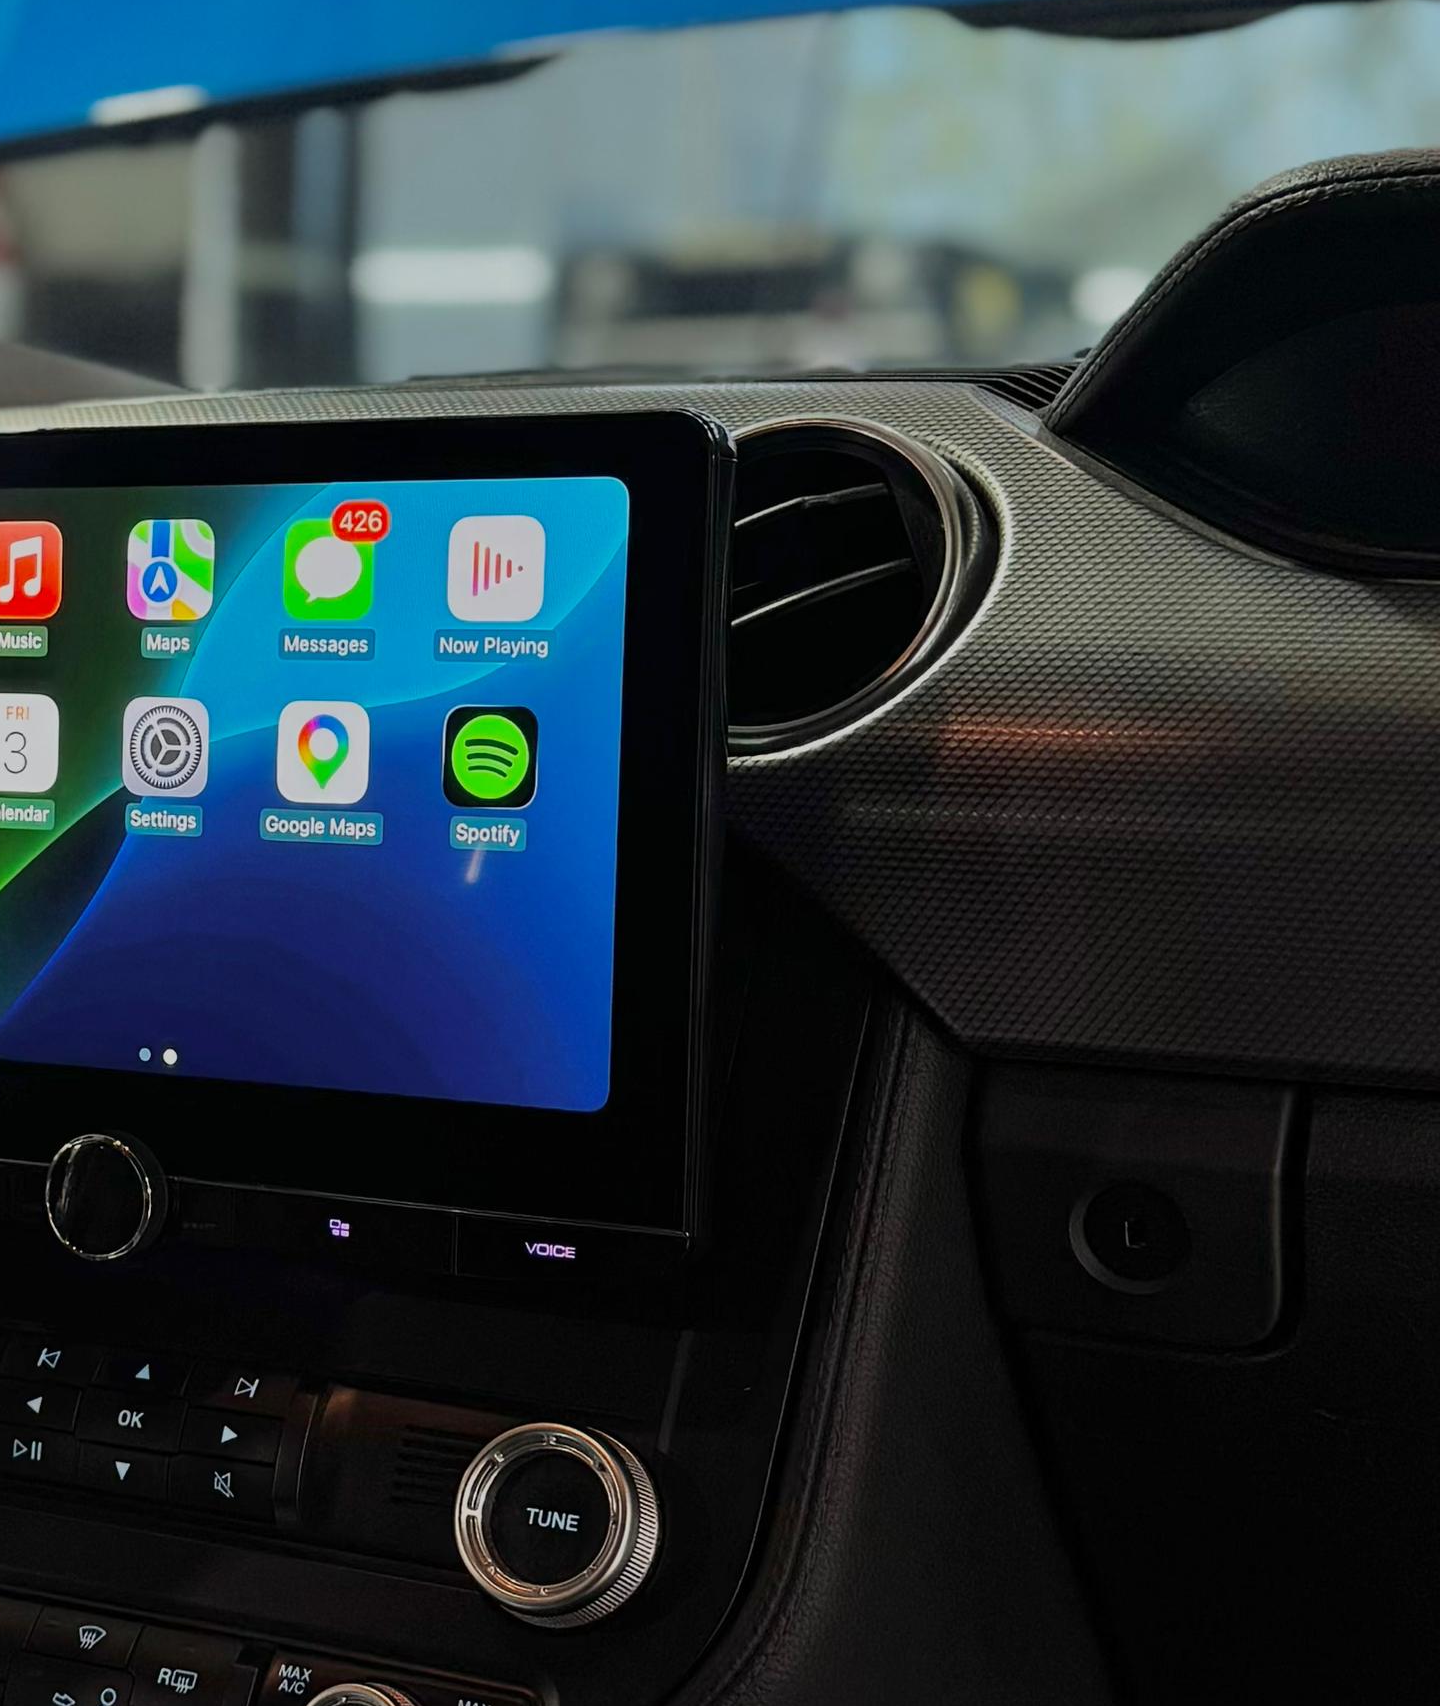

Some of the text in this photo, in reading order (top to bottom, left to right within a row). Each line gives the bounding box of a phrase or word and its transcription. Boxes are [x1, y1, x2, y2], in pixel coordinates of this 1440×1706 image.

[339, 509, 383, 533] 426
[146, 633, 191, 653] Maps
[284, 635, 369, 655] Messages
[439, 637, 549, 659] Now Playing
[6, 706, 30, 720] FRI
[4, 731, 28, 774] 3
[130, 810, 197, 831] Settings
[265, 816, 376, 840] Google Maps
[455, 823, 520, 846] Spotify
[525, 1242, 577, 1259] VOICE
[117, 1410, 144, 1429] OK
[526, 1508, 580, 1533] TUNE
[278, 1664, 313, 1683] MAX
[278, 1679, 307, 1696] A/C
